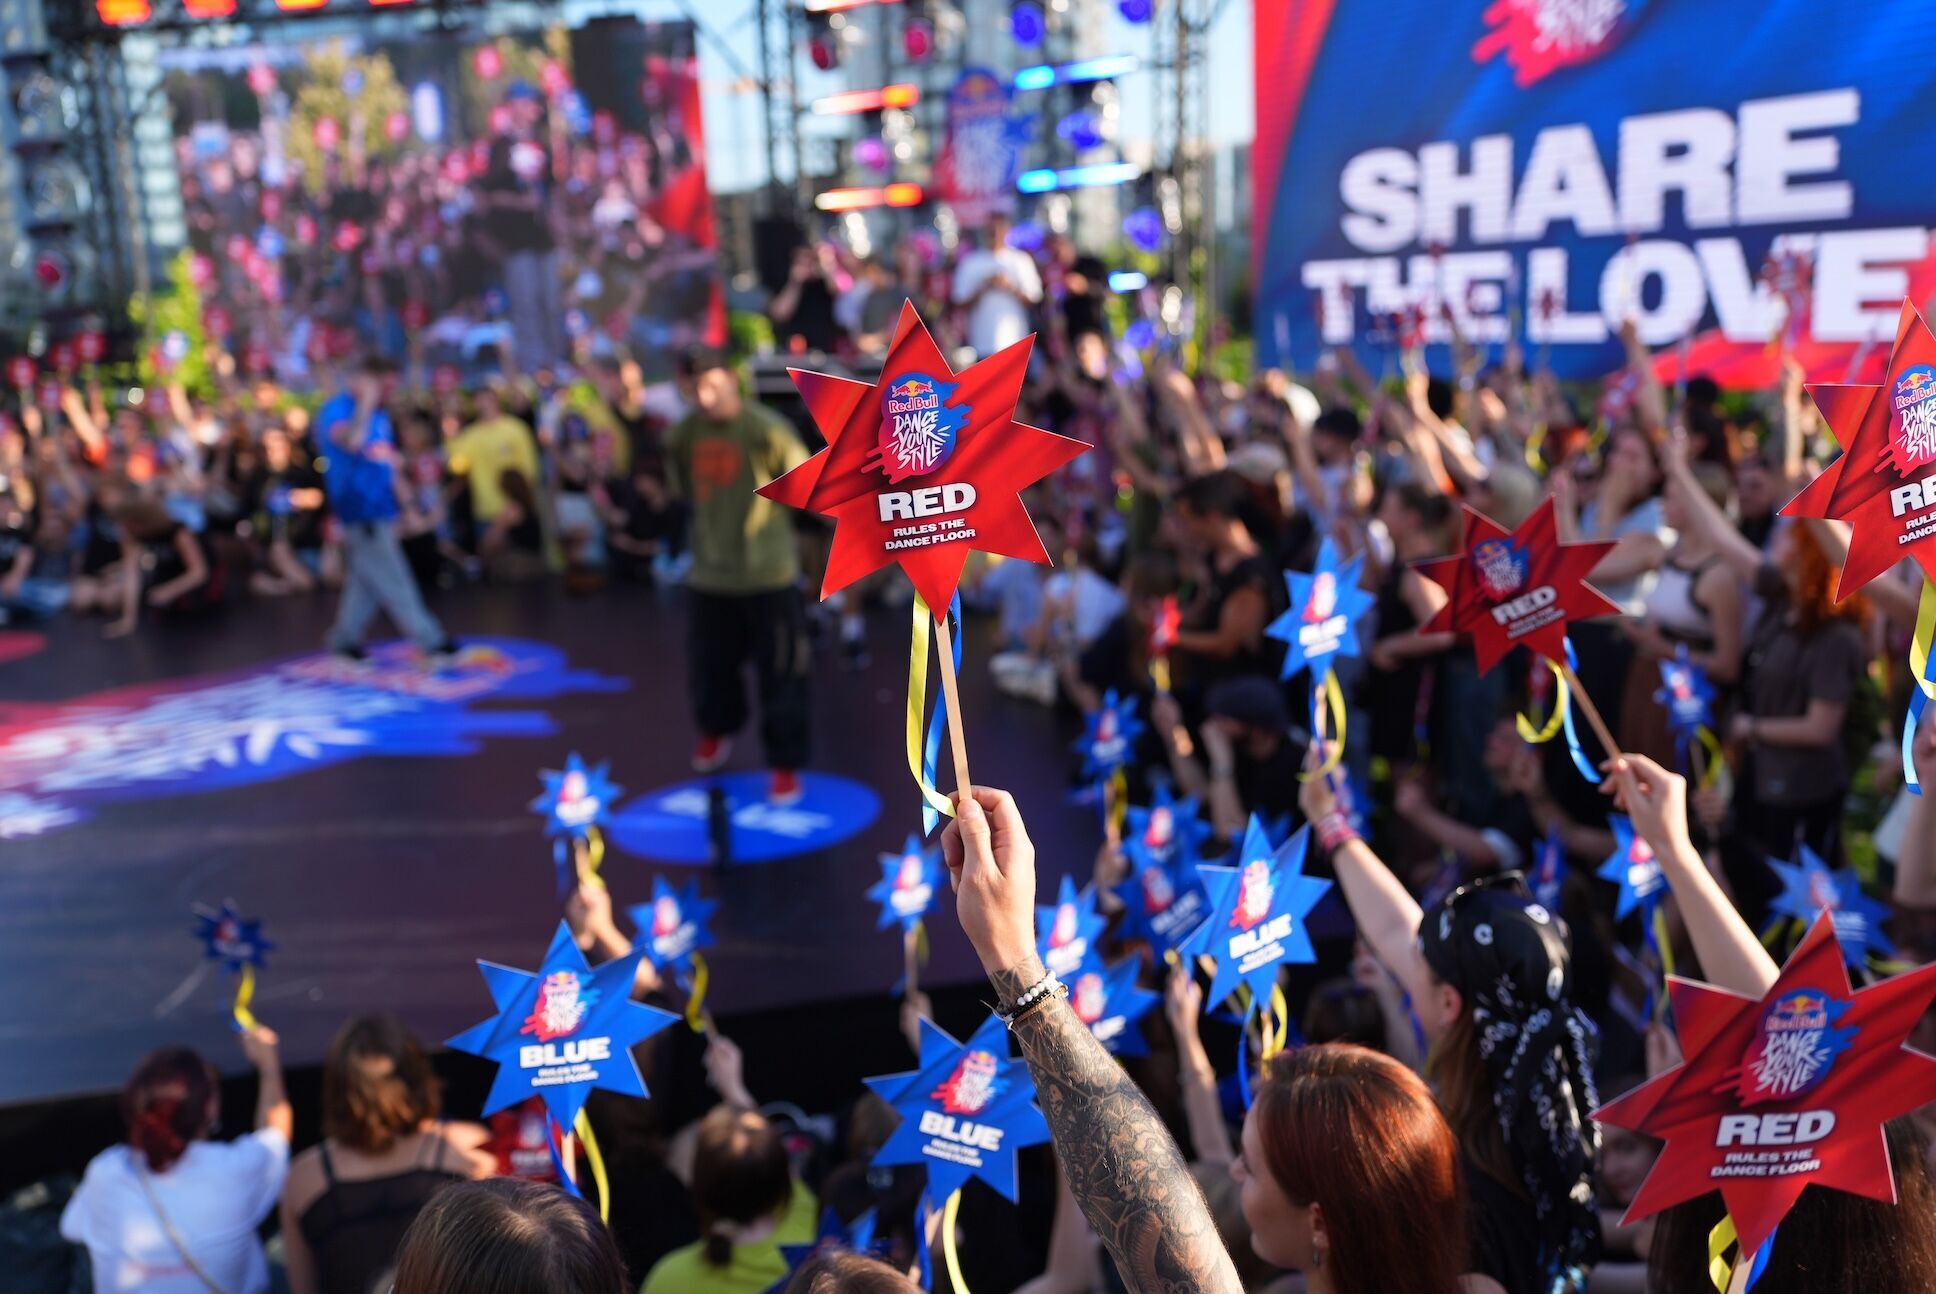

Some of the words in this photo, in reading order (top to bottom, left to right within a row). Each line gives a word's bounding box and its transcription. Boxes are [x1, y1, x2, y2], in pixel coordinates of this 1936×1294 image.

[1340, 87, 1859, 253] SHARE
[1301, 250, 1515, 345] THE
[1528, 226, 1928, 346] LOVE
[889, 397, 914, 413] Red
[914, 393, 939, 411] Bull
[1895, 389, 1918, 410] Red
[892, 410, 940, 437] DANCE
[898, 424, 947, 452] YOUR
[897, 438, 943, 471] STYLE
[1905, 430, 1936, 462] STYL
[878, 482, 977, 522] RED
[1890, 473, 1936, 517] RE
[893, 523, 938, 537] RULES
[938, 518, 966, 530] THE
[1905, 511, 1936, 530] RULE
[885, 536, 931, 550] DANCE
[931, 528, 976, 544] FLOOR
[1490, 585, 1558, 625] RED
[1228, 913, 1293, 960] BLUE
[519, 1036, 612, 1069] BLUE
[919, 1109, 1005, 1152] BLUE
[1715, 1109, 1836, 1147] RED
[1710, 1165, 1768, 1177] DANCE
[1768, 1159, 1821, 1175] FLOOR
[1725, 1151, 1780, 1164] RULES
[1780, 1147, 1814, 1162] THE
